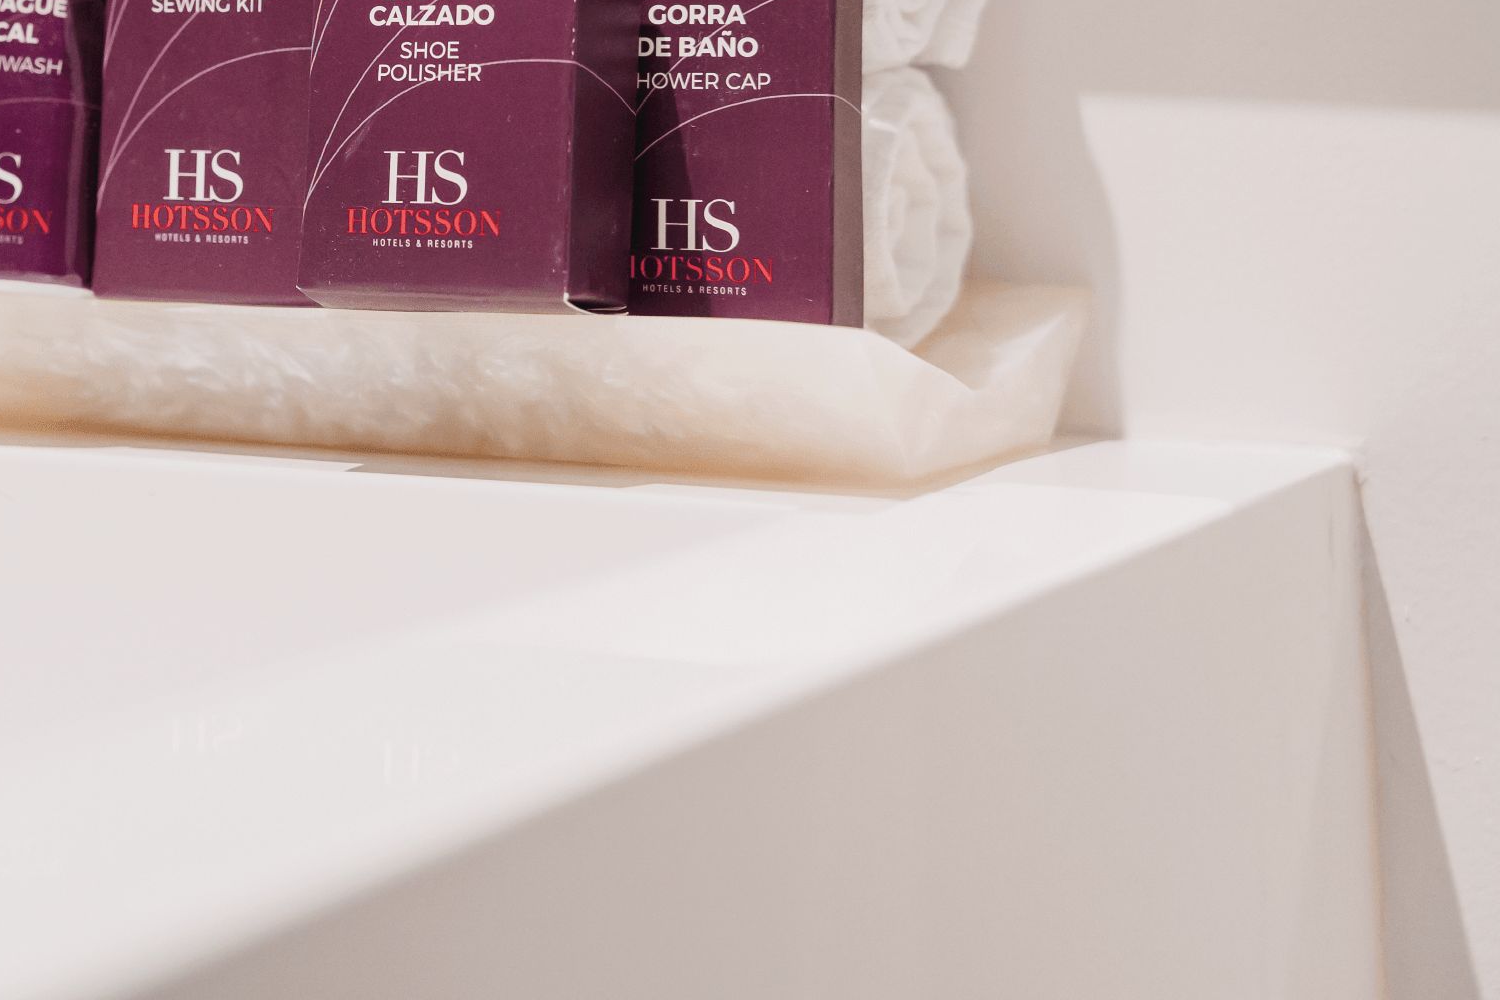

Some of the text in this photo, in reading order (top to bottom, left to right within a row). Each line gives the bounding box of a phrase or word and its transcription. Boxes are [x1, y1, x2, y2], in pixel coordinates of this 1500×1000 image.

[369, 4, 495, 26] CALZADO
[647, 4, 747, 25] GORRA
[400, 41, 460, 60] SHOE
[637, 30, 759, 57] DE BAÑO
[377, 63, 482, 82] POLISHER
[636, 72, 771, 90] HOWER CAP
[163, 149, 244, 203] HS
[381, 150, 468, 206] HS
[131, 203, 275, 233] HOTSSON
[347, 207, 501, 237] HOTSSON
[650, 199, 740, 253] HS
[154, 233, 192, 243] HOTELS
[206, 234, 250, 244] RESORTS
[372, 238, 474, 249] HOTELS & RESORTS
[642, 284, 748, 296] HOTELS & RESORTS
